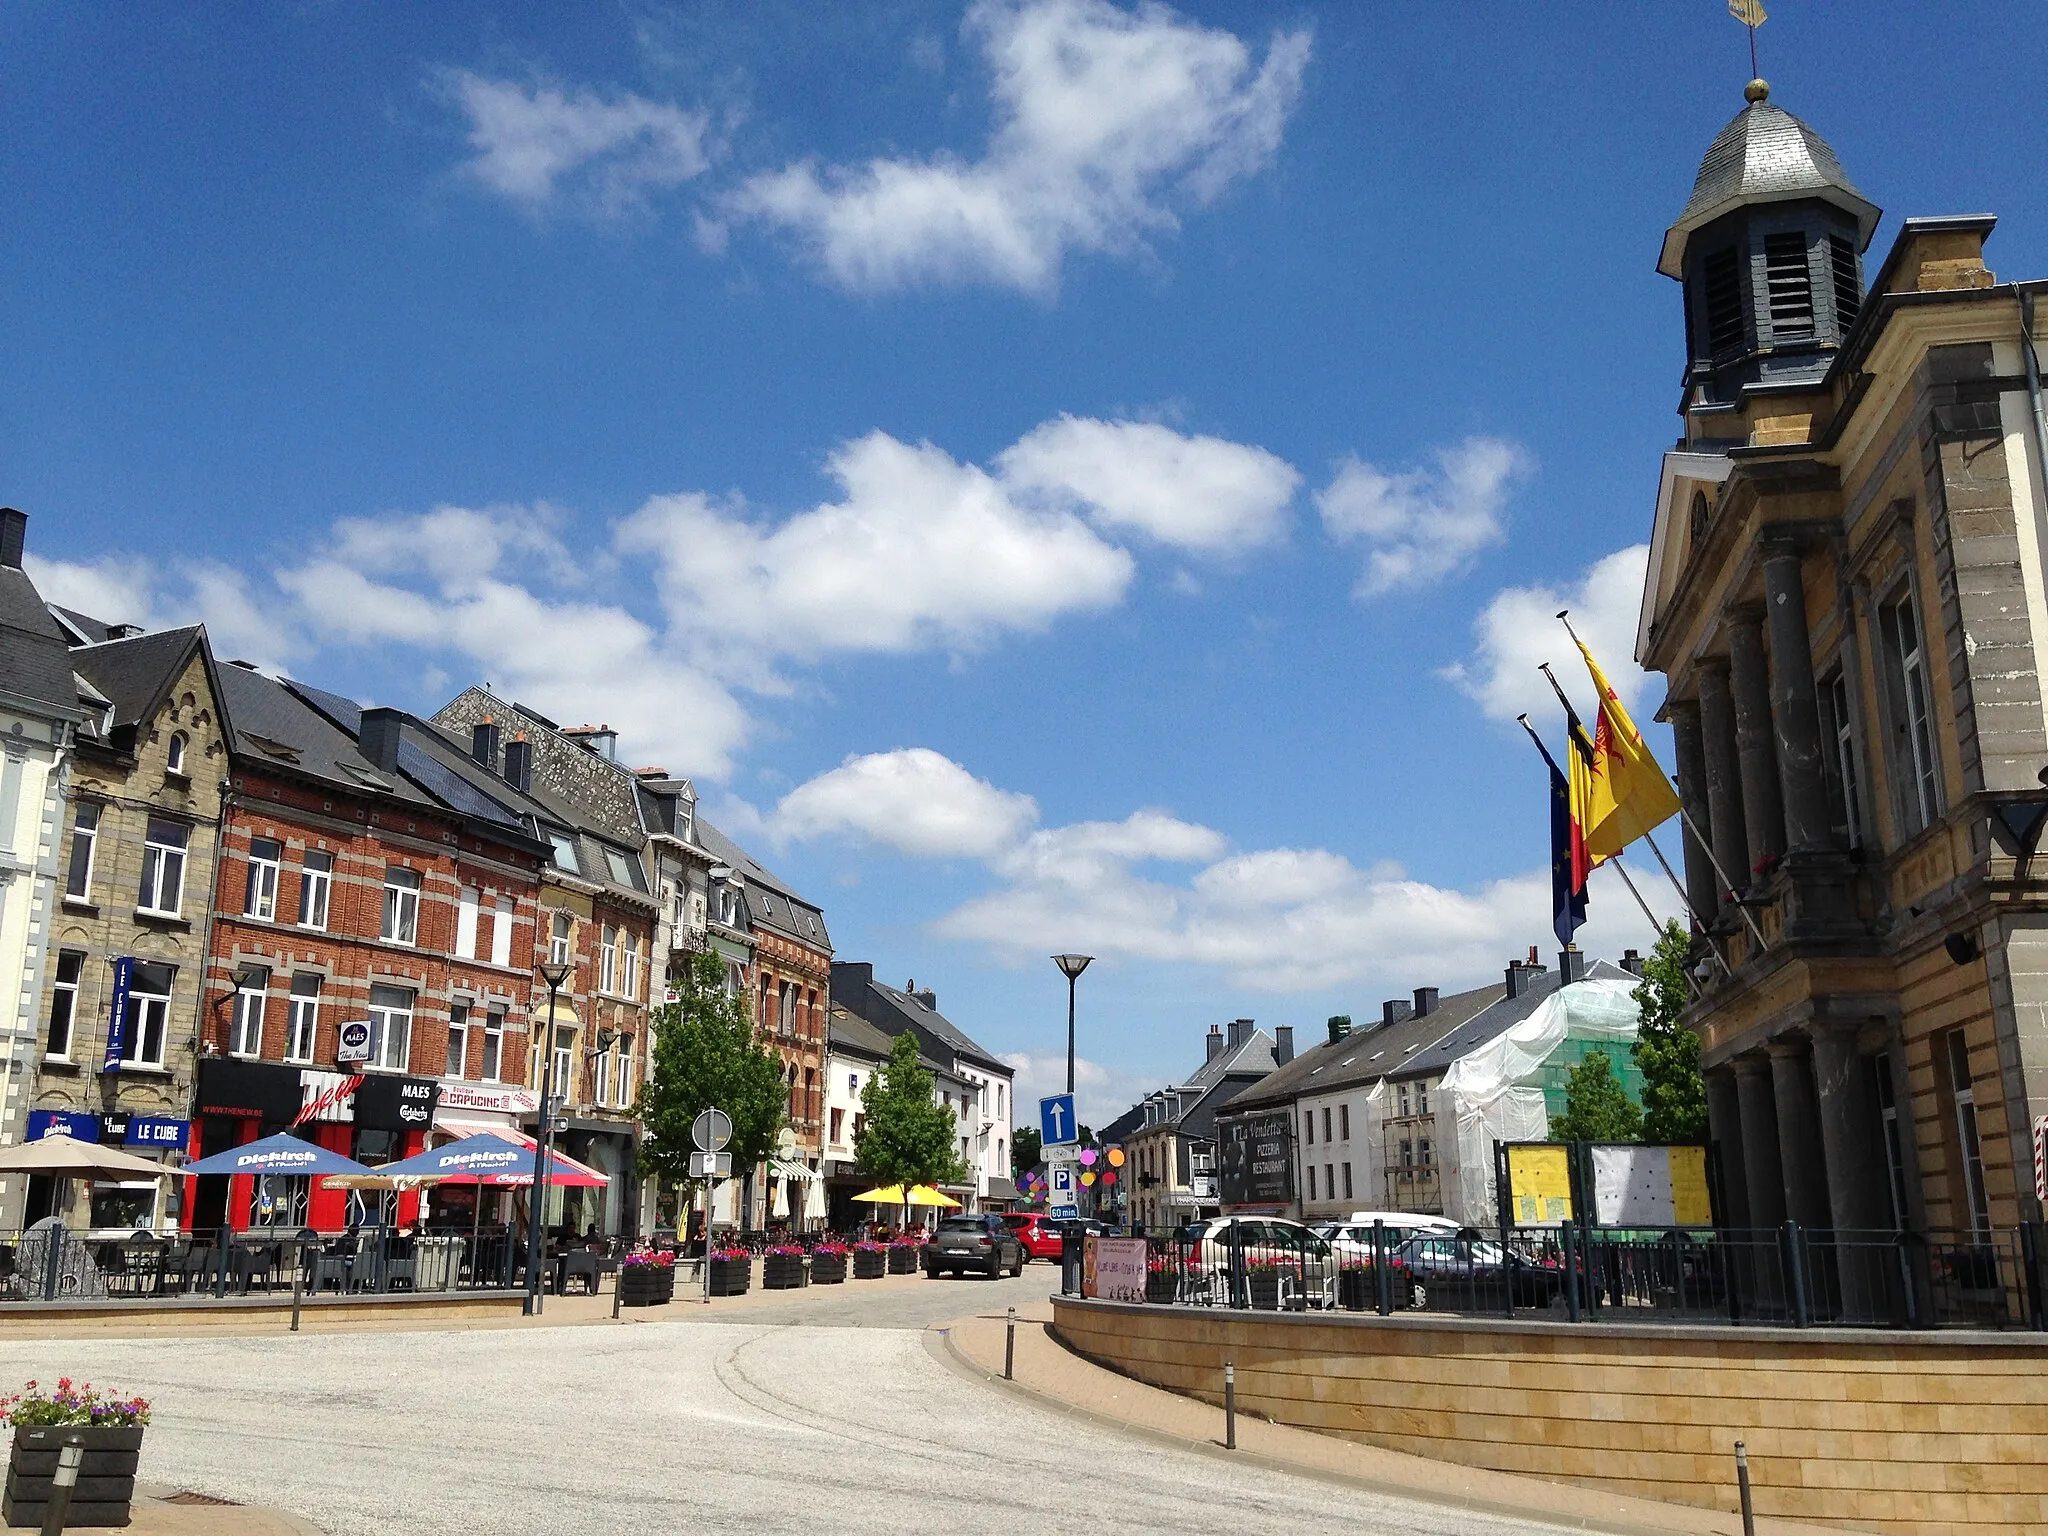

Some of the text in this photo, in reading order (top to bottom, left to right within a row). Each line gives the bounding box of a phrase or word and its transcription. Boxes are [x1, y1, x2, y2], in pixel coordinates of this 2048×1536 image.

[120, 964, 126, 987] LE
[114, 992, 124, 1037] CUBE
[345, 1033, 365, 1042] MAES
[401, 1085, 431, 1099] MAES
[449, 1093, 500, 1109] CAPUCINE
[104, 1116, 113, 1125] LE
[400, 1104, 428, 1122] Carlsberg
[107, 1124, 126, 1134] CUBE
[138, 1124, 179, 1141] LE CUBE
[1257, 1142, 1280, 1157] PIZZERIA
[237, 1151, 318, 1167] Diekirch
[438, 1151, 519, 1167] Diekirch
[1252, 1160, 1286, 1174] RESTAURANT
[1056, 1171, 1068, 1189] P
[1052, 1208, 1061, 1218] 60
